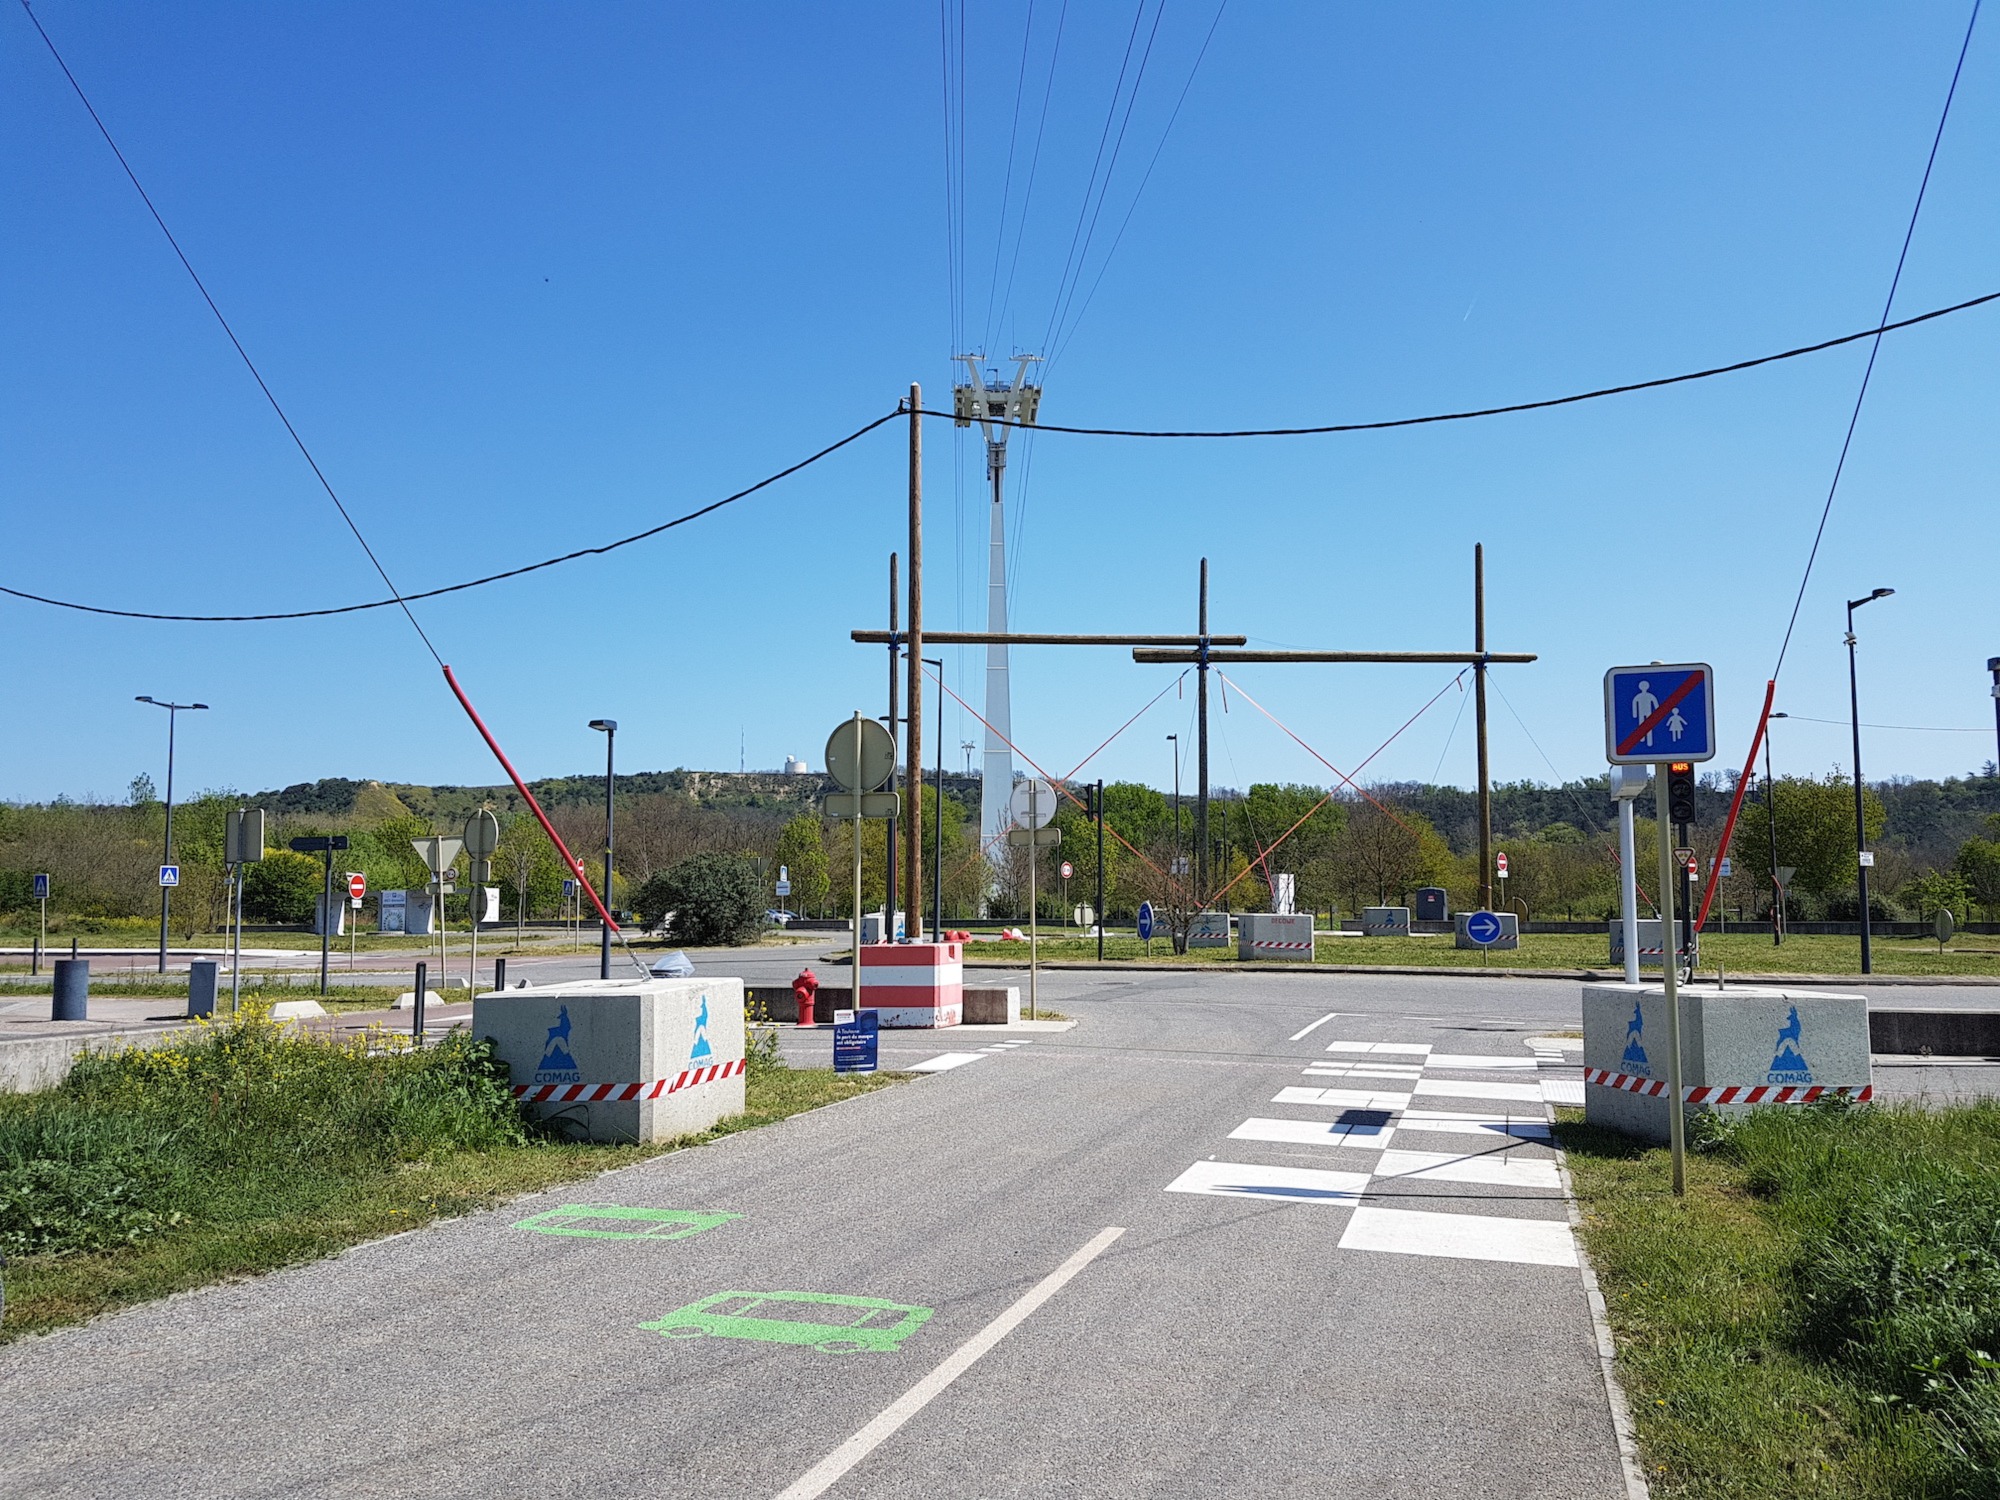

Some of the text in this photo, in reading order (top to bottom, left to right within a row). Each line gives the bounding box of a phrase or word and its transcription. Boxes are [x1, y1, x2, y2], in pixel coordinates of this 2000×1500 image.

[1672, 762, 1689, 771] BUS
[687, 1056, 714, 1071] COMAG
[1620, 1061, 1651, 1076] COMAG
[534, 1072, 580, 1083] COMAG
[1767, 1072, 1812, 1084] COMAG
